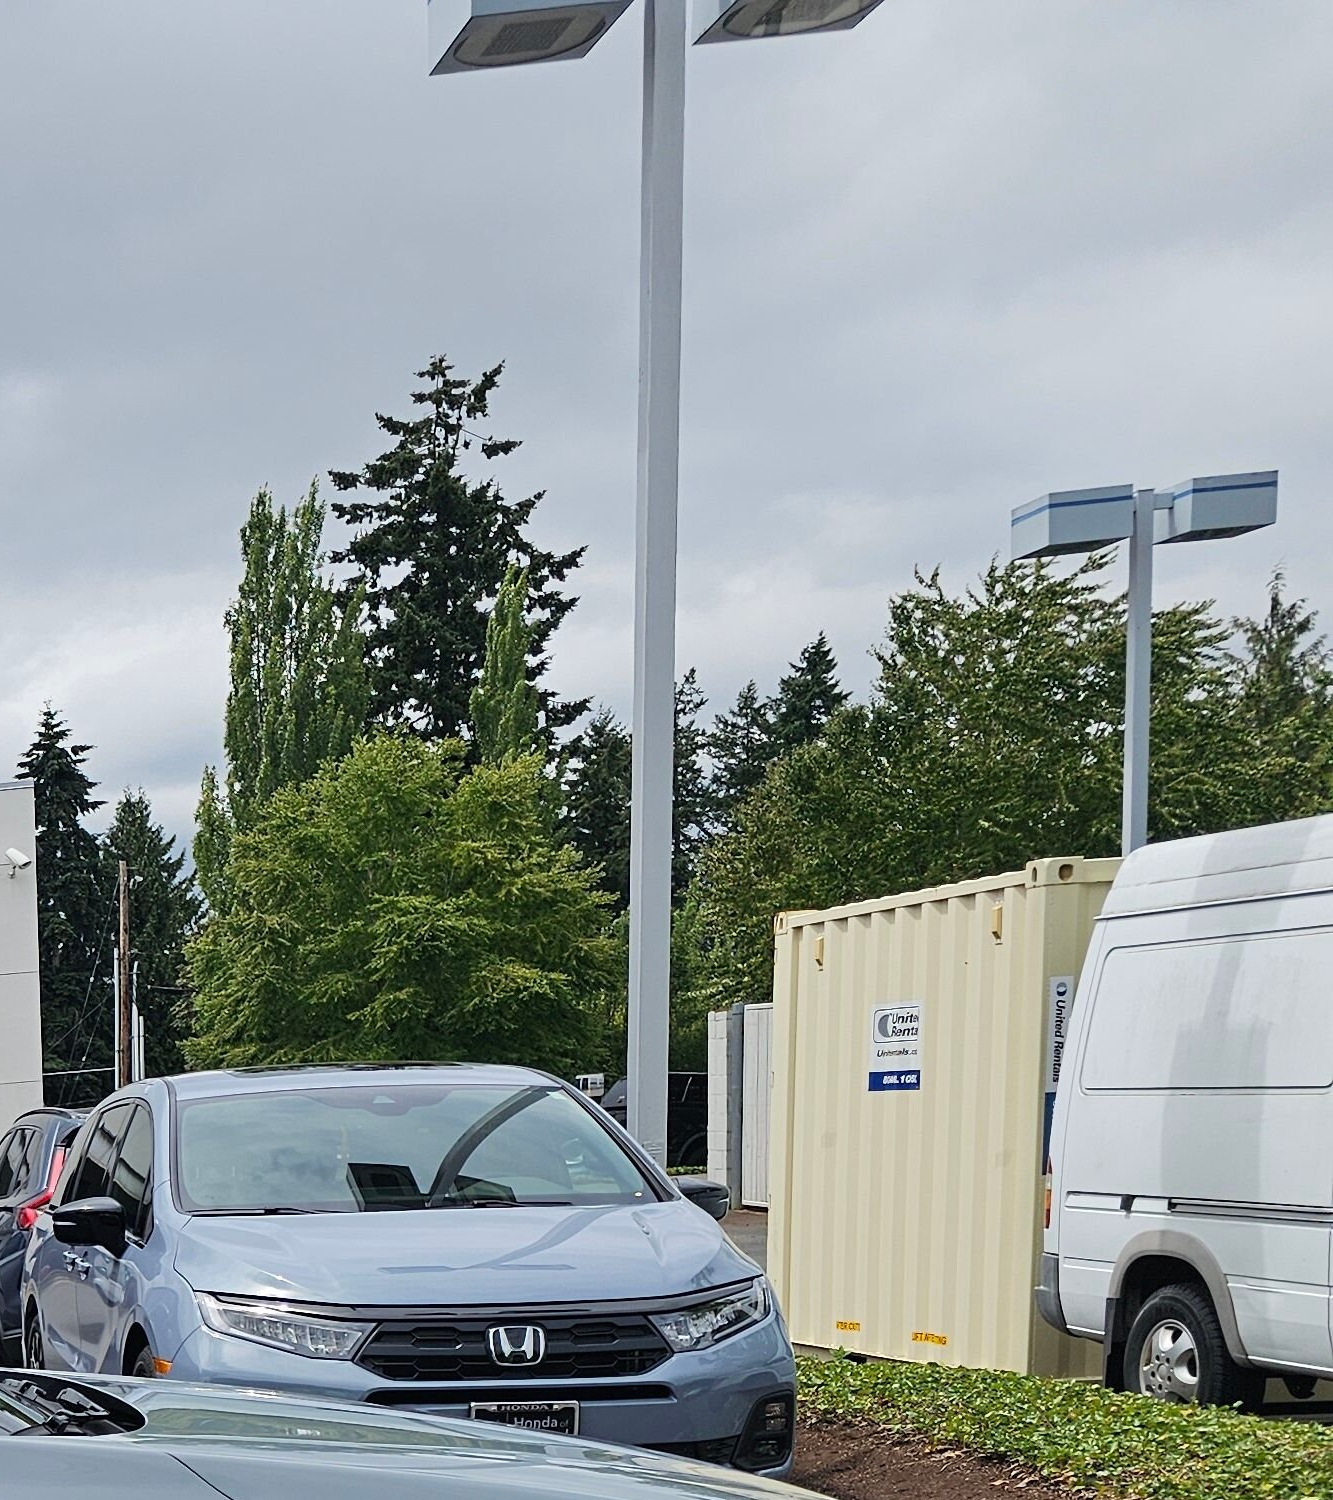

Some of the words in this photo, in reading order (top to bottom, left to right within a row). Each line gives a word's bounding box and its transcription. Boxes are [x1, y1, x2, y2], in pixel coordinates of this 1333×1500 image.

[1055, 1000, 1066, 1039] United
[501, 1404, 549, 1412] HONDA
[514, 1415, 558, 1430] Honda
